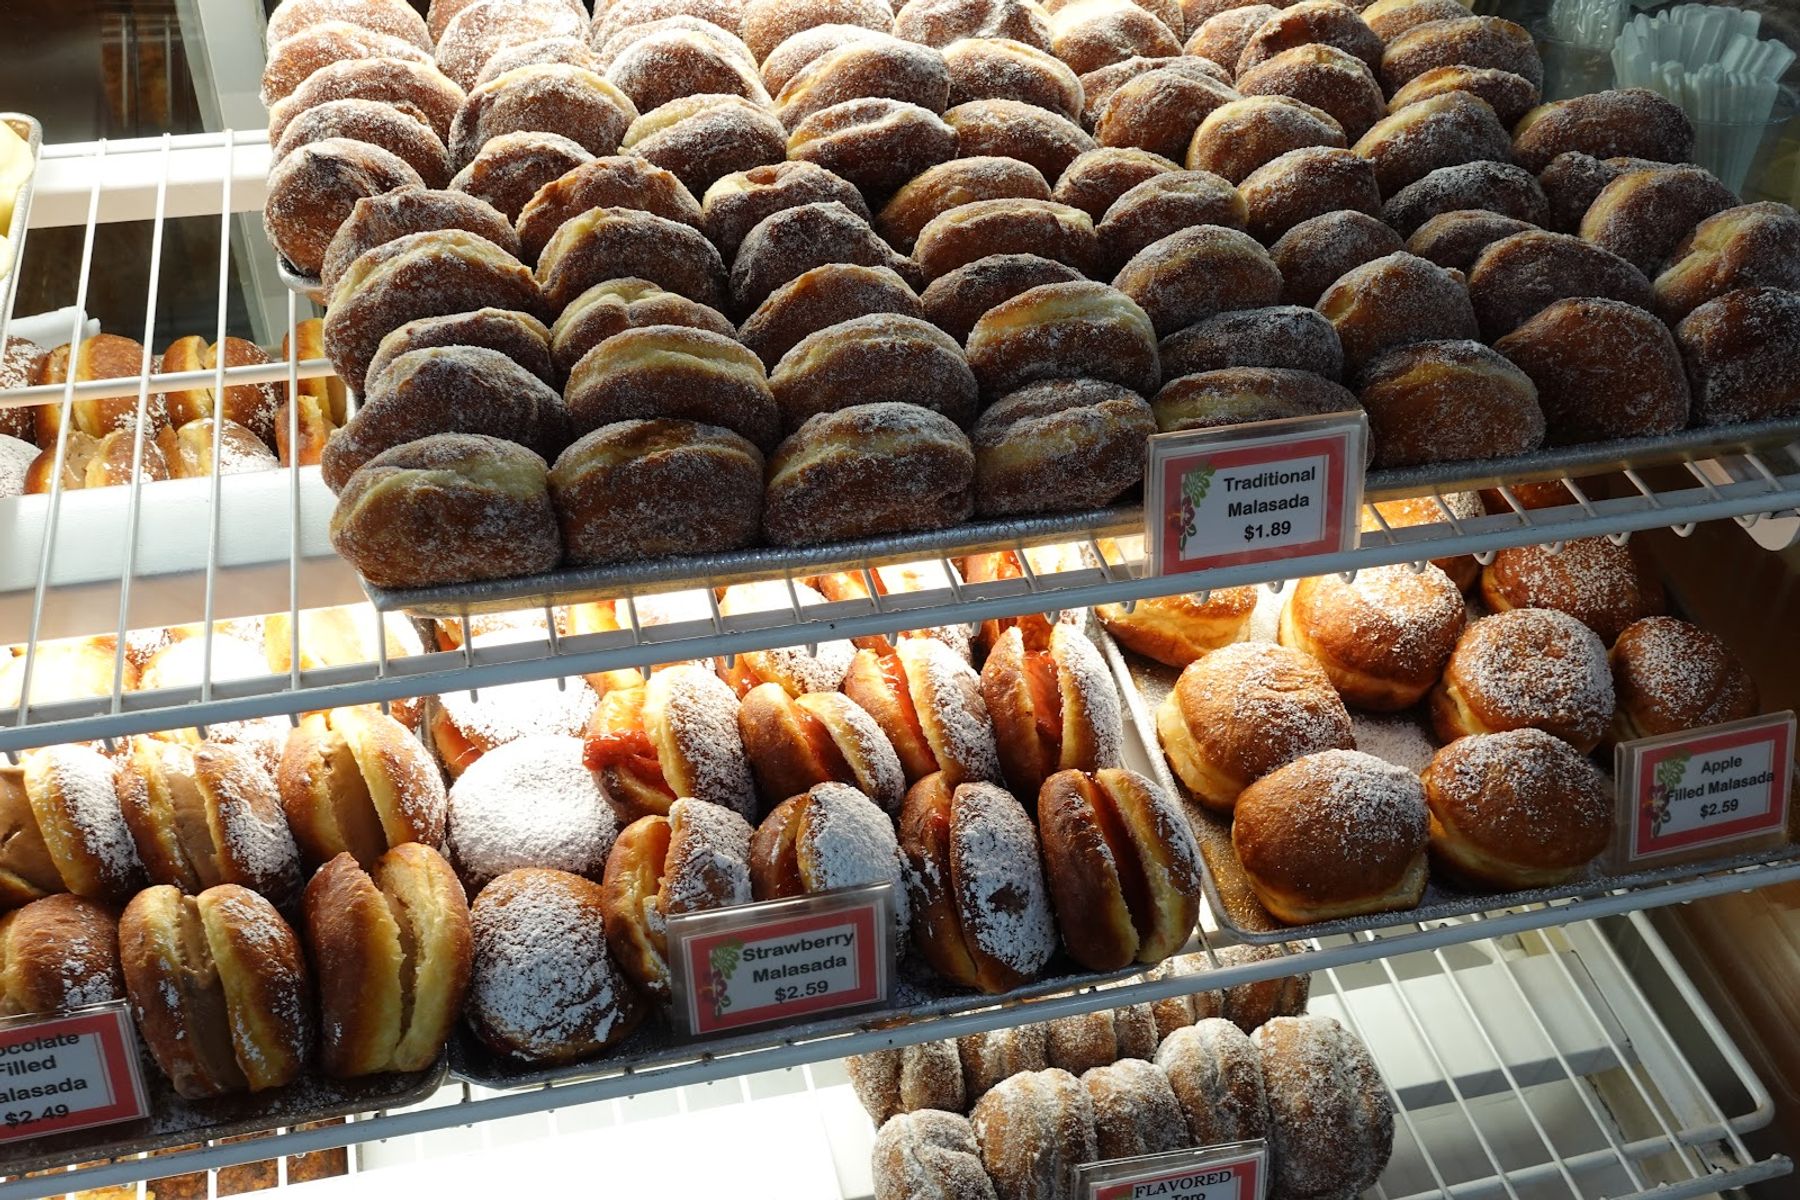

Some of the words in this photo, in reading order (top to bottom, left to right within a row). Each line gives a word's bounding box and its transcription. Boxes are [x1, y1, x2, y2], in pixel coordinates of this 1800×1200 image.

[1224, 466, 1316, 492] Traditional
[1228, 493, 1310, 518] Malasada
[1243, 520, 1292, 542] $1.89
[1701, 756, 1743, 775] Apple
[1708, 771, 1775, 795] Malasada
[1700, 799, 1739, 819] $2.59
[742, 932, 854, 962] Strawberry
[753, 955, 847, 983] Malasada
[774, 980, 829, 1004] $2.59
[4, 1104, 69, 1129] $2.49
[1134, 1170, 1232, 1198] FLAVORED
